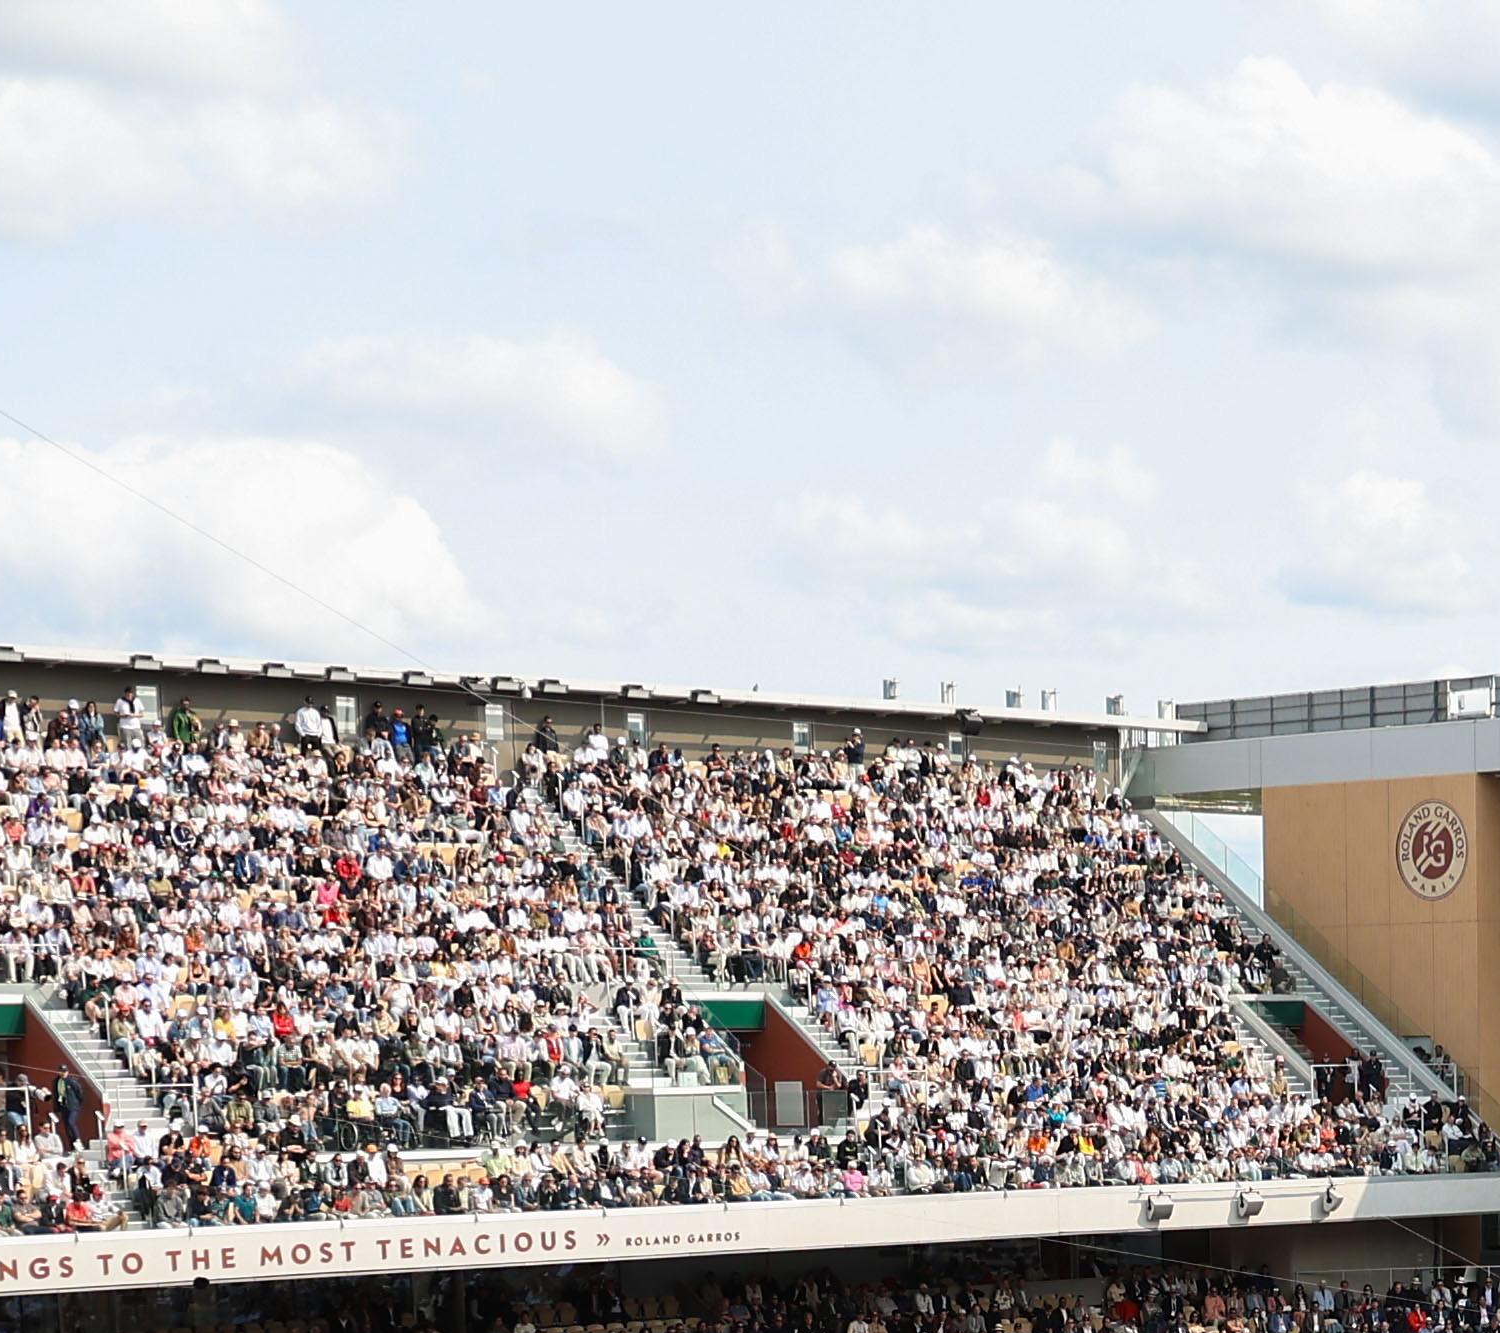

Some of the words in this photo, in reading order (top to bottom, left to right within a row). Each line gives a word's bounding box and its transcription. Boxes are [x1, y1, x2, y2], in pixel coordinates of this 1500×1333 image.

[1401, 806, 1430, 862] ROLAND
[1434, 806, 1465, 859] GARROS
[1411, 872, 1455, 893] PARIS
[97, 1252, 144, 1277] TO
[166, 1246, 238, 1273] THE
[259, 1239, 358, 1269] MOST
[376, 1229, 579, 1262] TENACIOUS
[625, 1234, 682, 1249] ROLAND
[686, 1231, 742, 1245] GARROS
